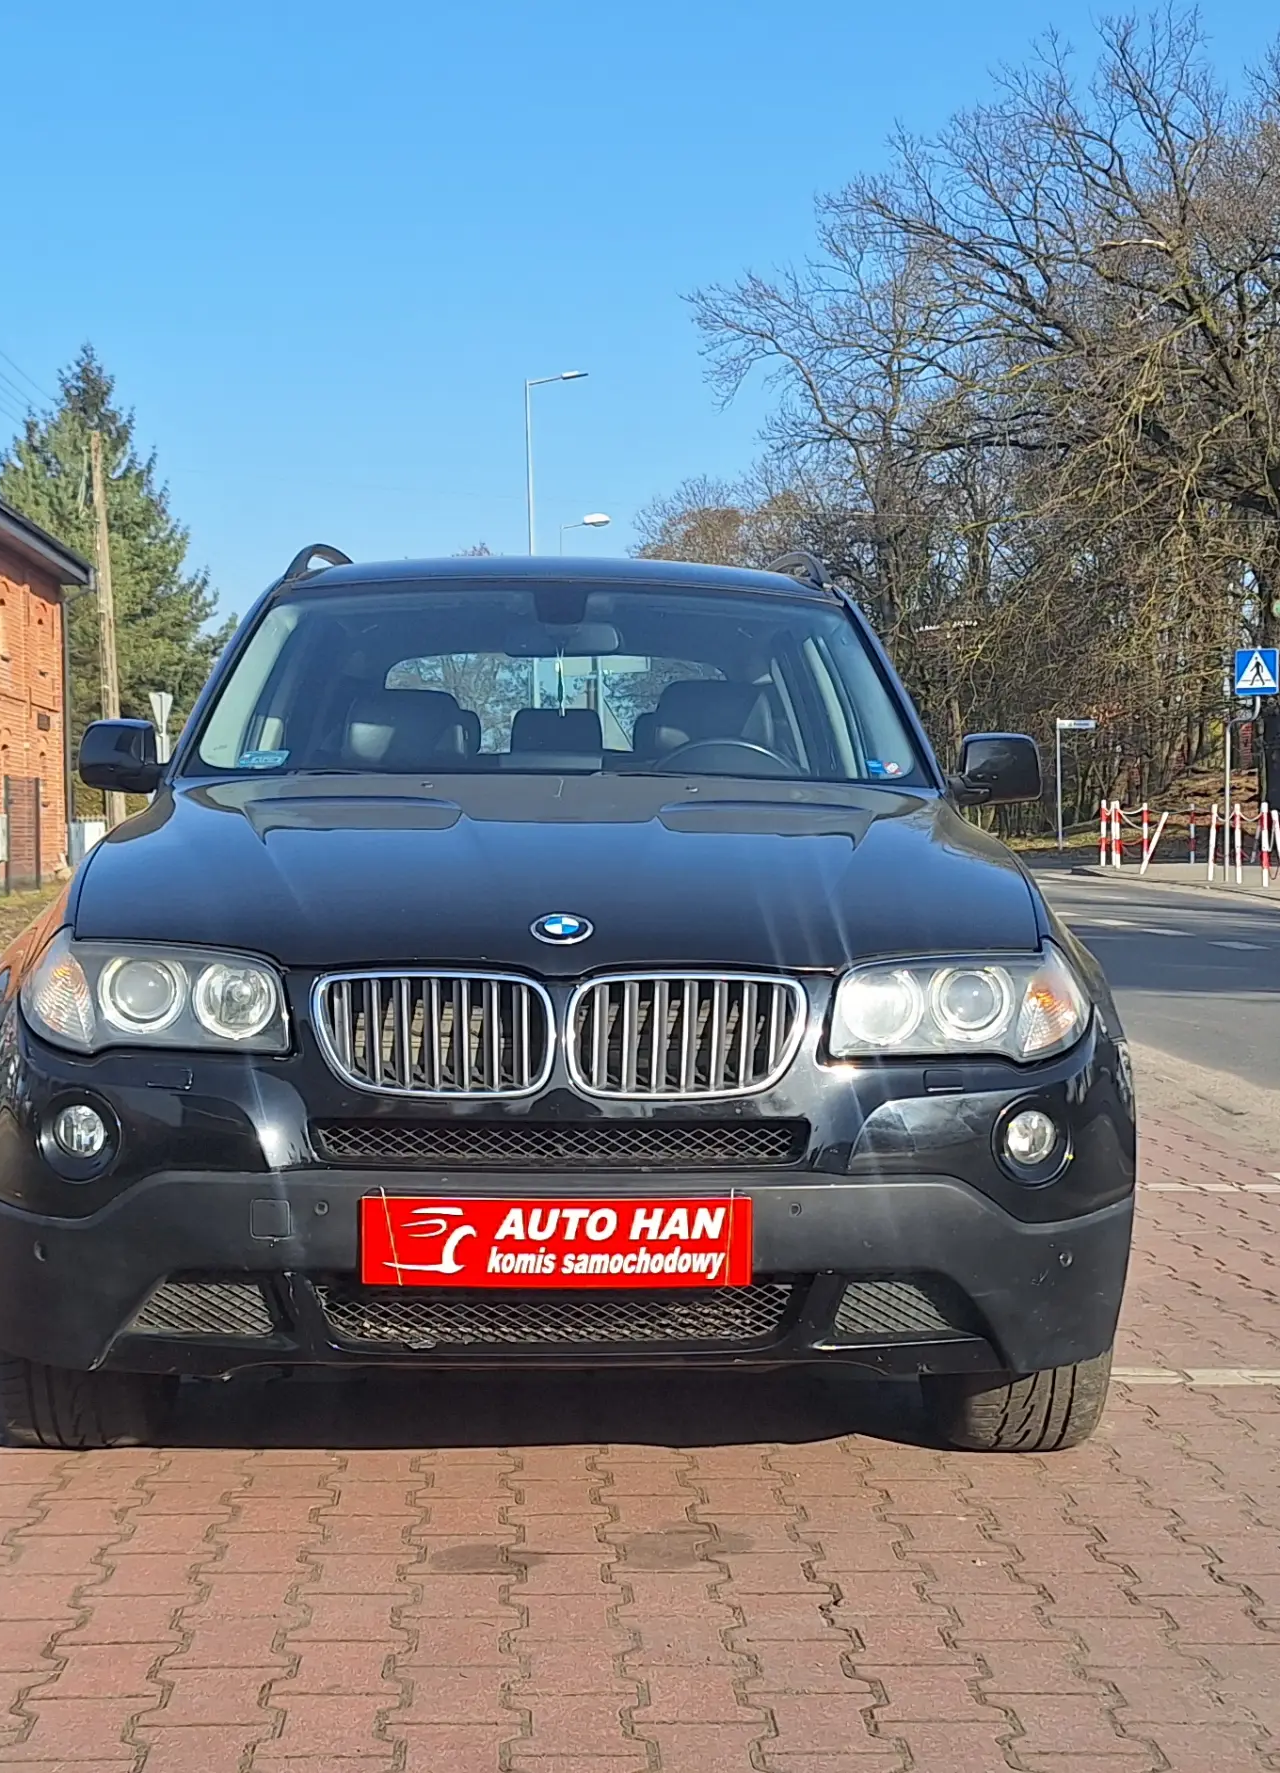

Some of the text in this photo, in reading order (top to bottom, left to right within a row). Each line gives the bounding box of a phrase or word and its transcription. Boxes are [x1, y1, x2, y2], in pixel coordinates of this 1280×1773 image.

[495, 1207, 726, 1242] AUTO HAN
[486, 1246, 726, 1280] komis samochodowy
